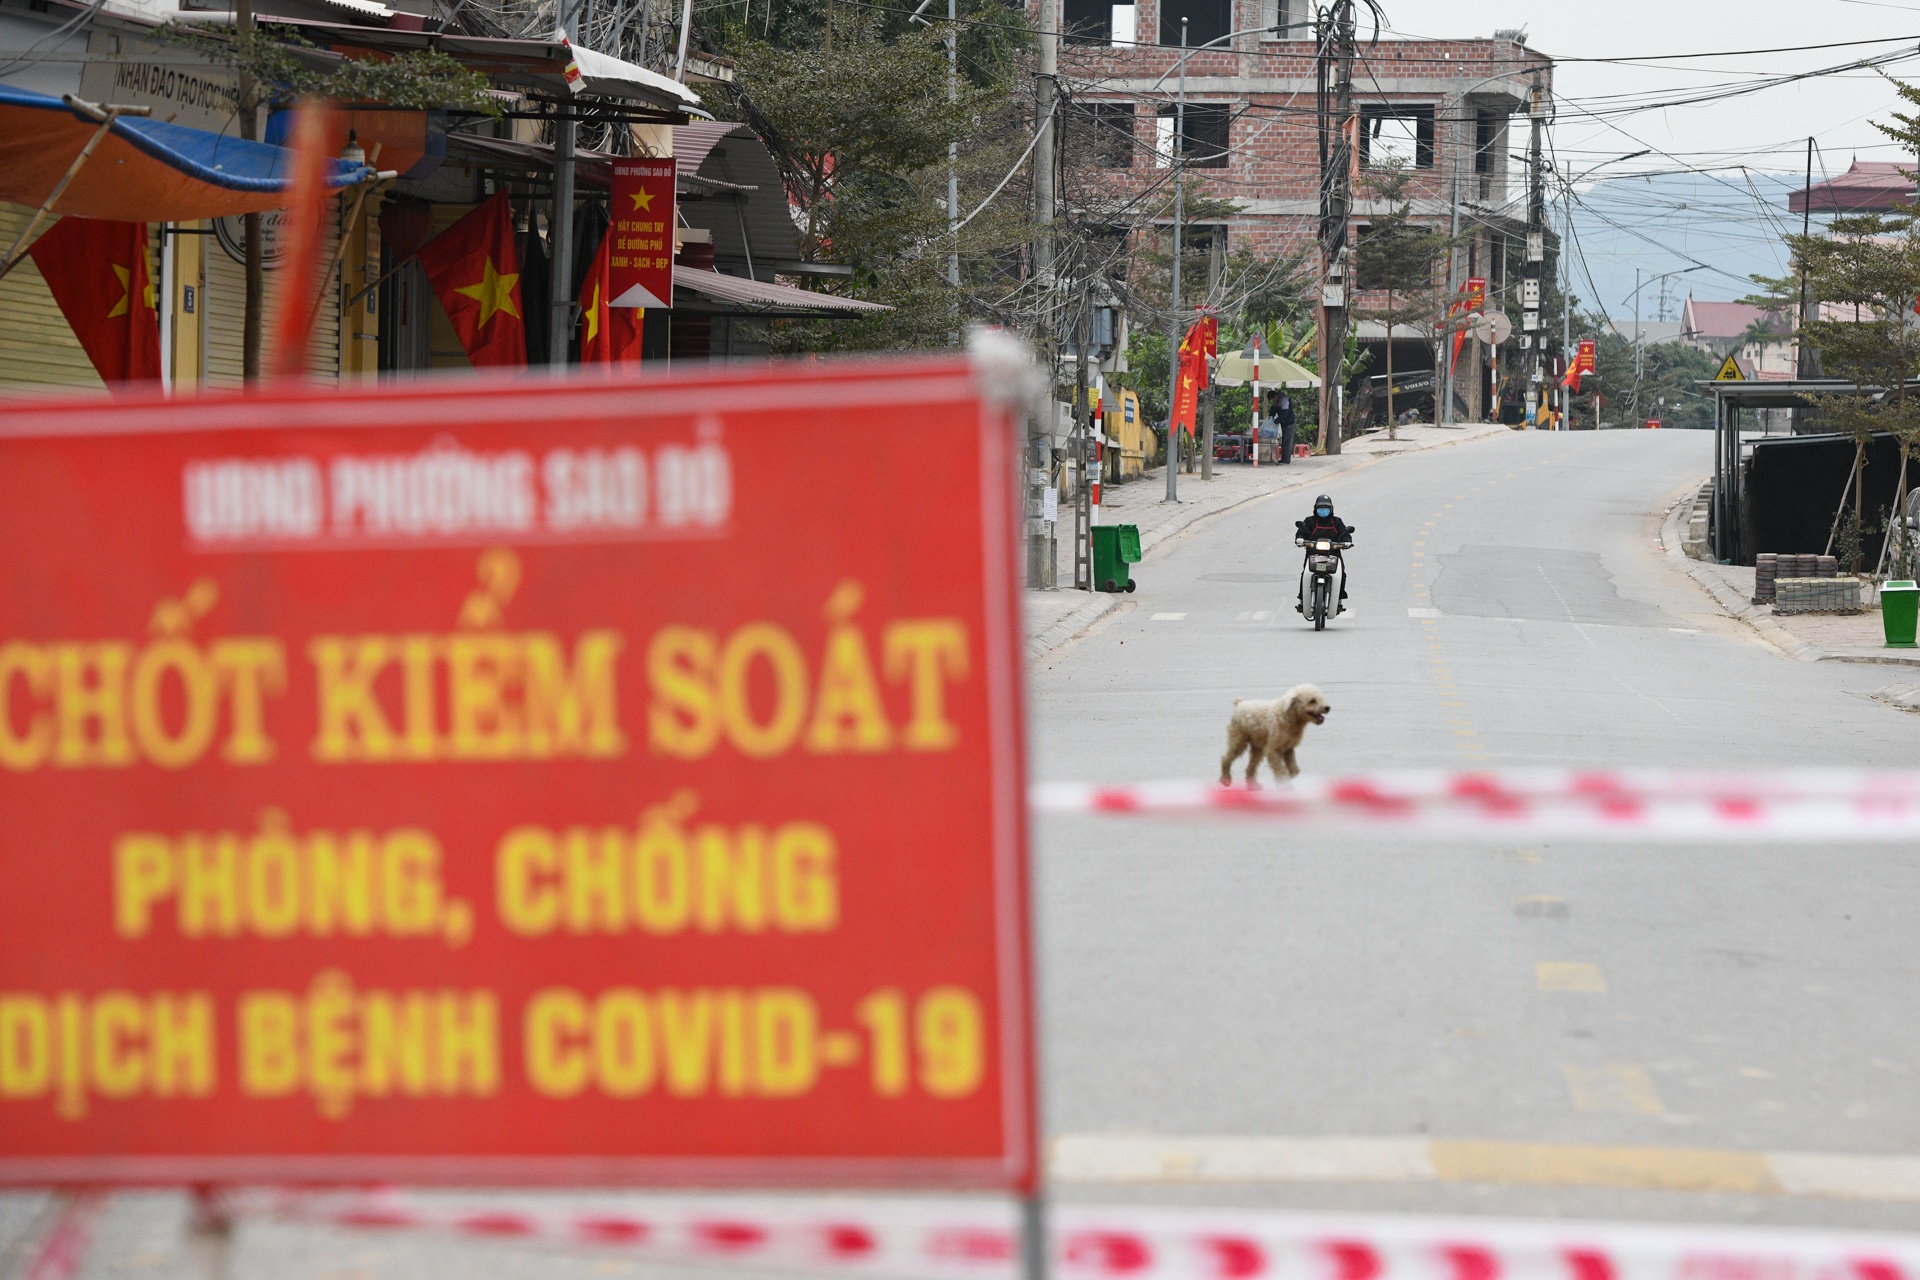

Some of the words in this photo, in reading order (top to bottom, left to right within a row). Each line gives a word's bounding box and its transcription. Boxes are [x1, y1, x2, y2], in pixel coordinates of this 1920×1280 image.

[611, 256, 628, 267] XANH
[633, 257, 651, 270] SẠCH
[631, 221, 653, 233] CHUNG
[653, 222, 665, 233] TAY
[1404, 381, 1429, 390] VOLVO
[0, 577, 288, 768] CHỐT
[308, 546, 629, 763] KIỂM
[645, 577, 972, 759] SOÁT
[495, 788, 842, 937] CHỐNG
[0, 989, 216, 1121] DỊCH
[237, 966, 500, 1121] BỆNH
[523, 986, 986, 1100] COVID-19
